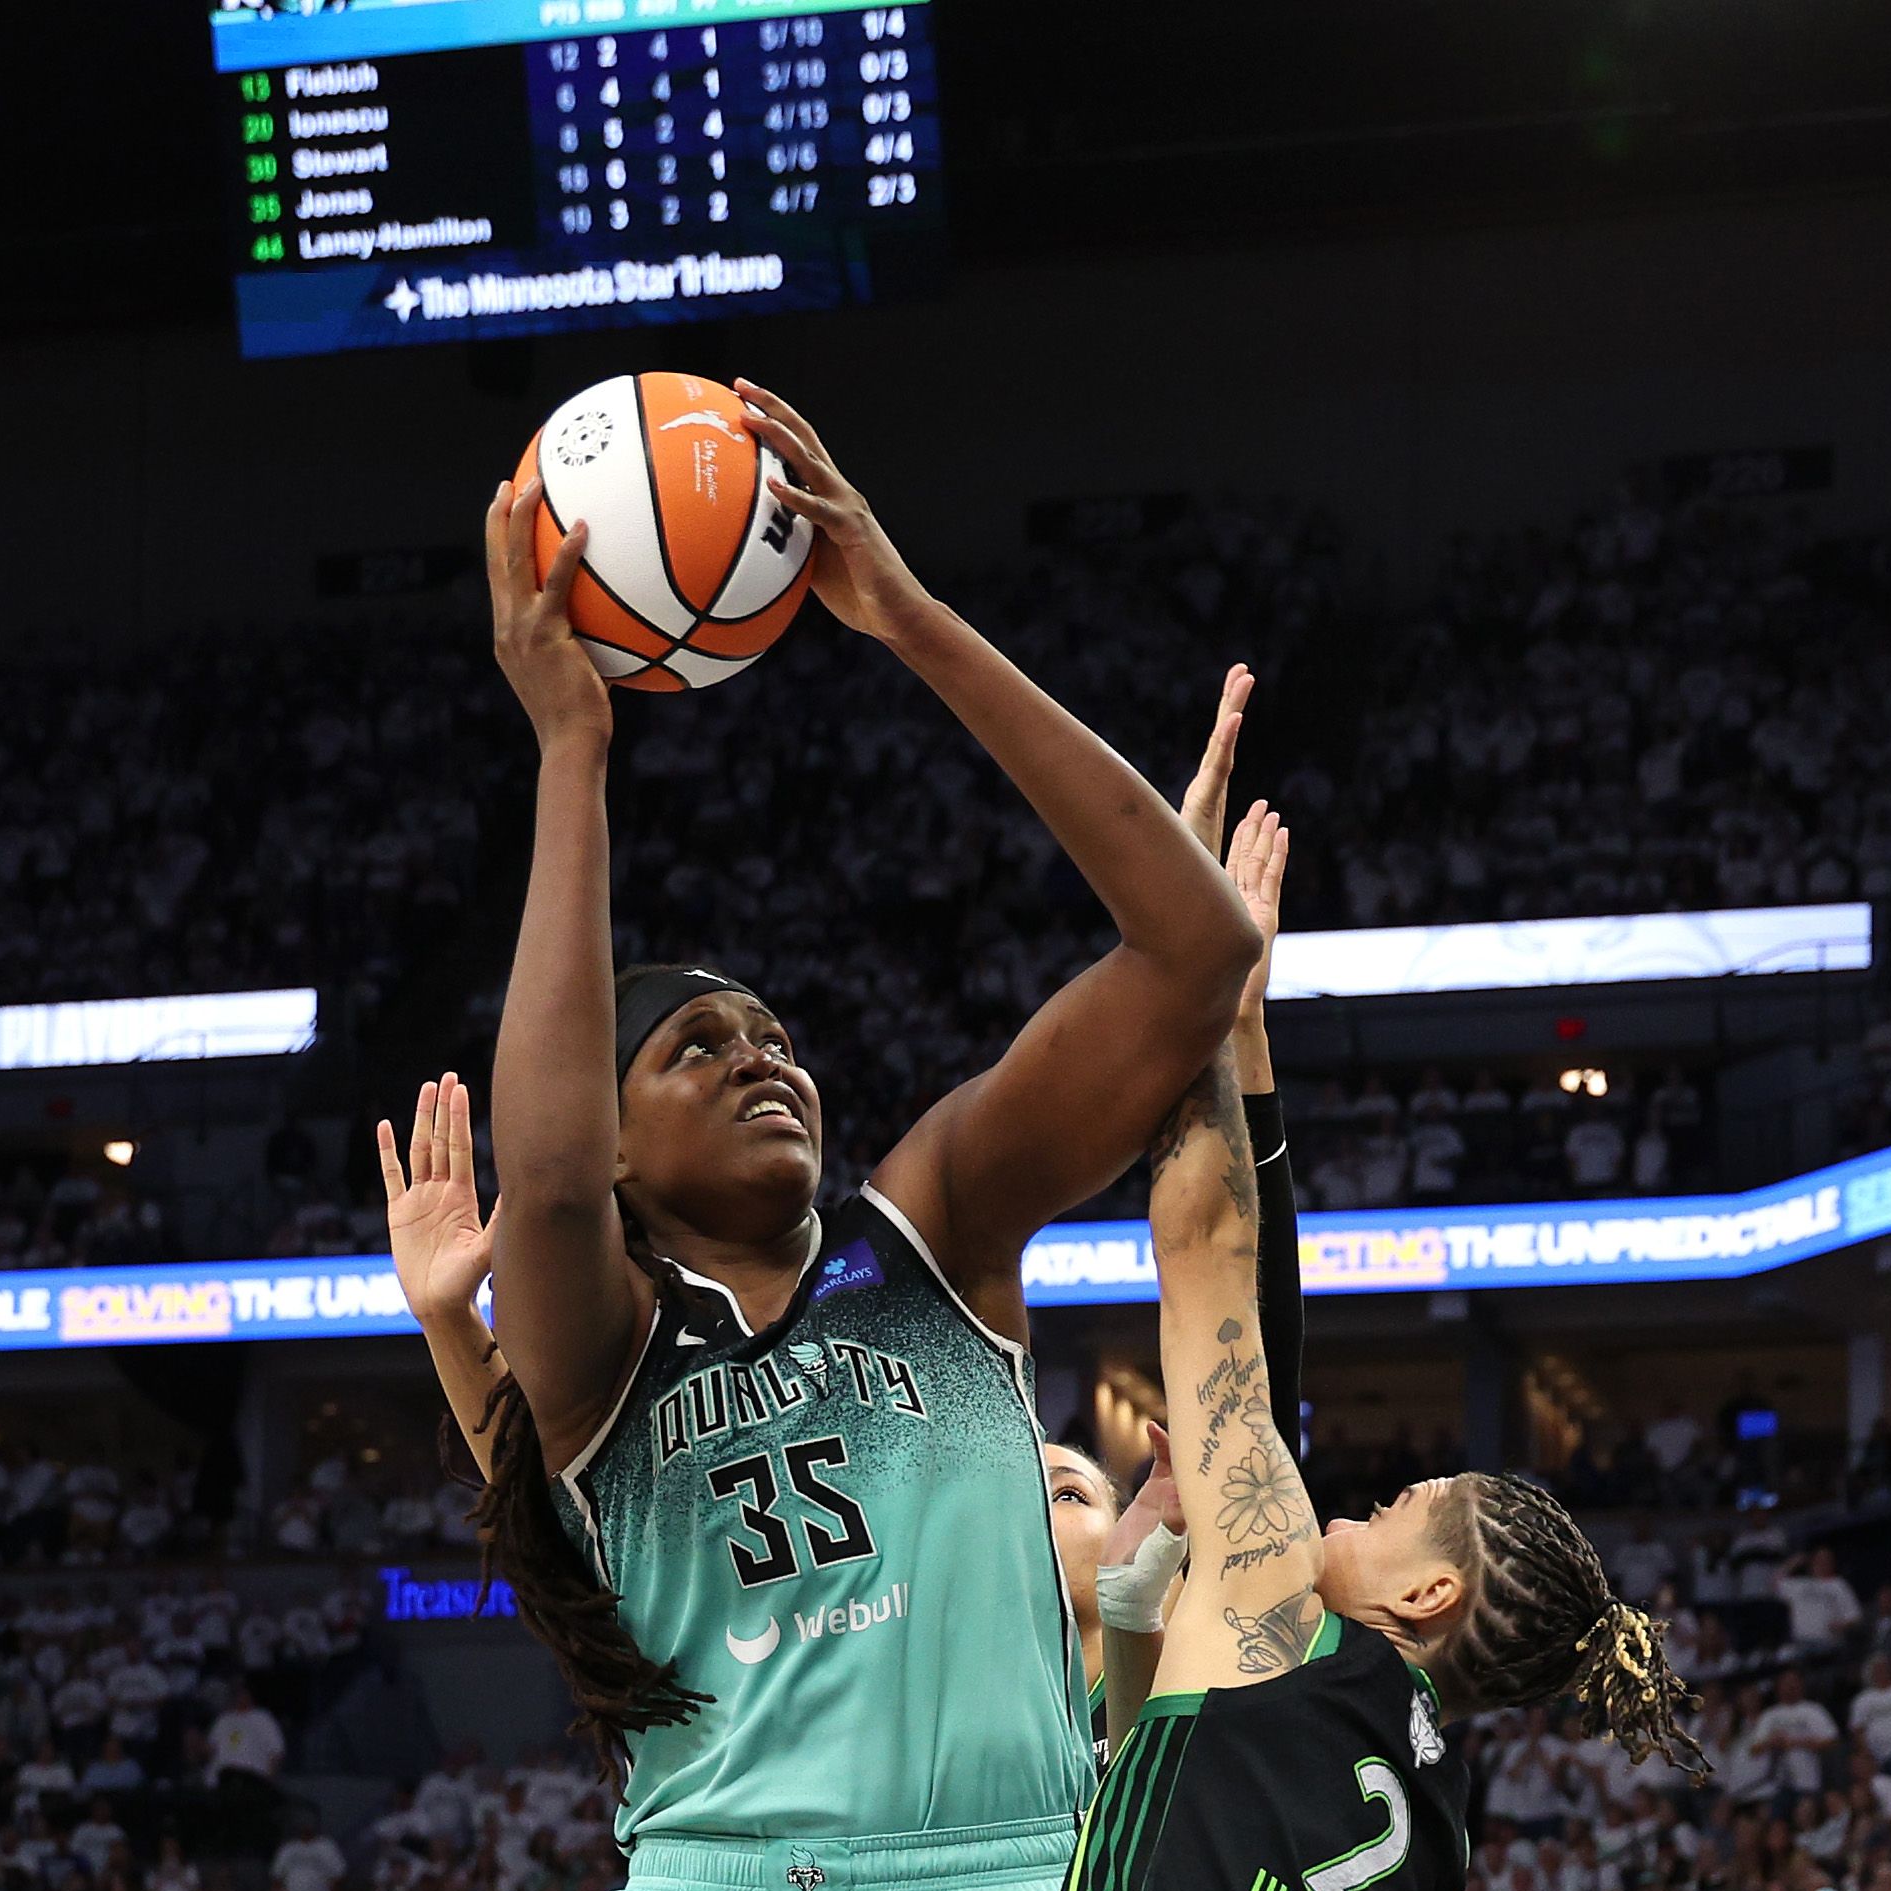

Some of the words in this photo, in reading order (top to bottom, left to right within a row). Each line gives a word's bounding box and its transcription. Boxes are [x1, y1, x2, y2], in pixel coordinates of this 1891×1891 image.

[417, 276, 469, 320] The
[468, 265, 614, 316] Minnesota
[613, 259, 676, 303] Star
[673, 252, 783, 297] Tribune
[1443, 1223, 1537, 1268] THE
[230, 1277, 312, 1320] THE
[708, 1434, 880, 1590] 35
[793, 1582, 908, 1644] Webull
